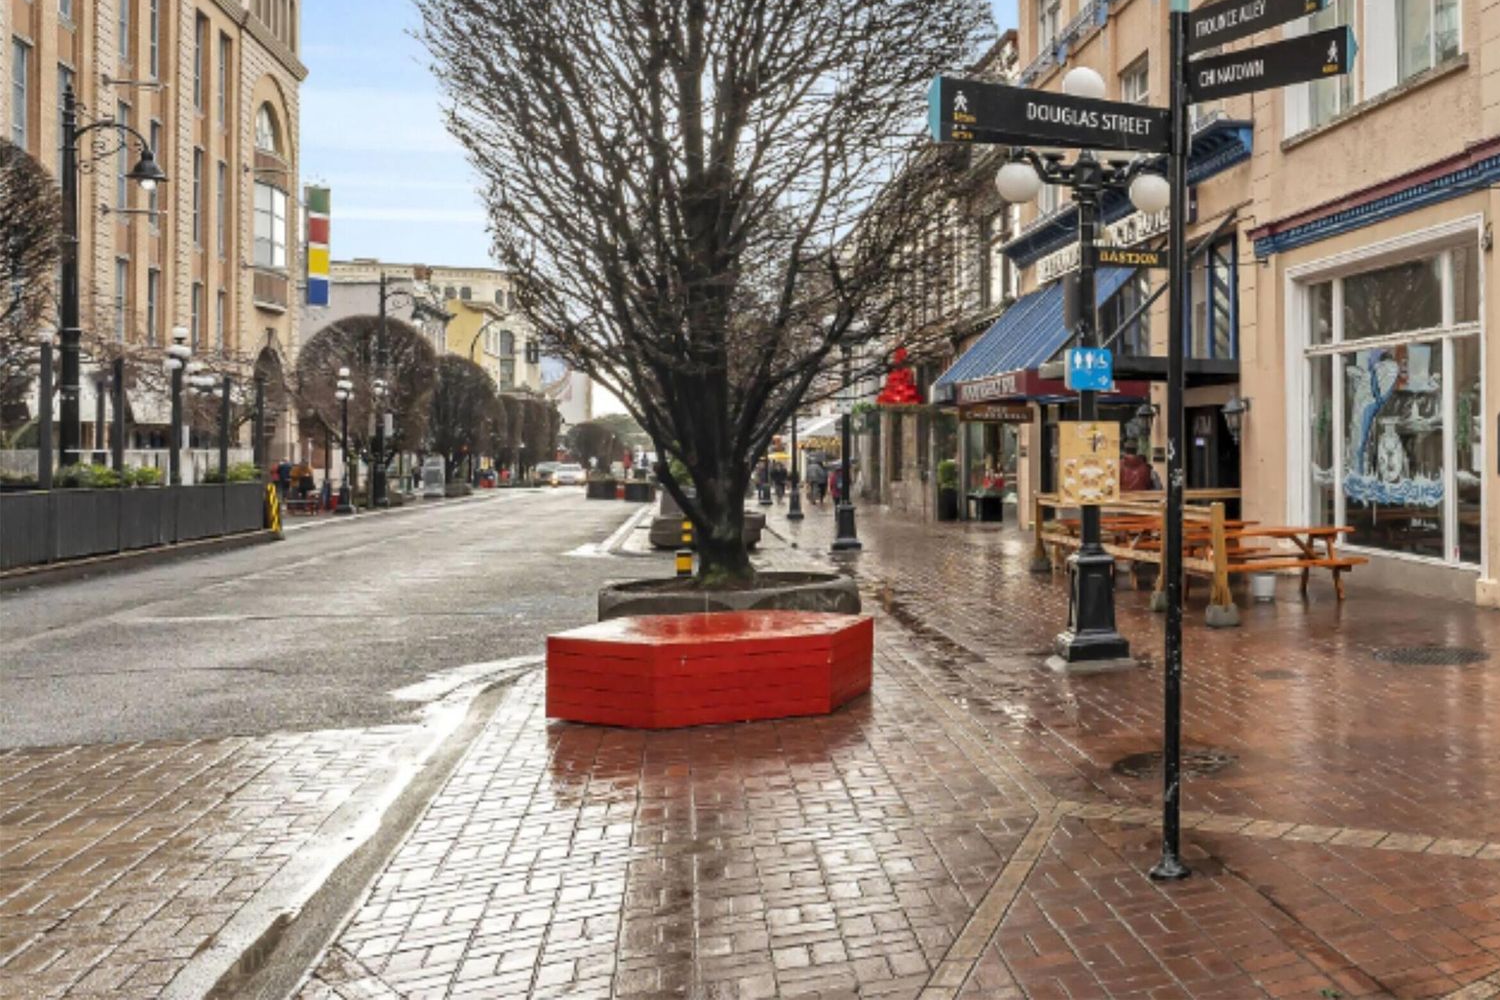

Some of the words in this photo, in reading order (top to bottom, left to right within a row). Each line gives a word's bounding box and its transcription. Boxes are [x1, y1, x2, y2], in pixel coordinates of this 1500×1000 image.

[1199, 59, 1264, 87] CHINATOWN
[1026, 101, 1099, 128] DOUGLAS
[1102, 113, 1152, 135] STREET
[1100, 251, 1158, 264] BASTION
